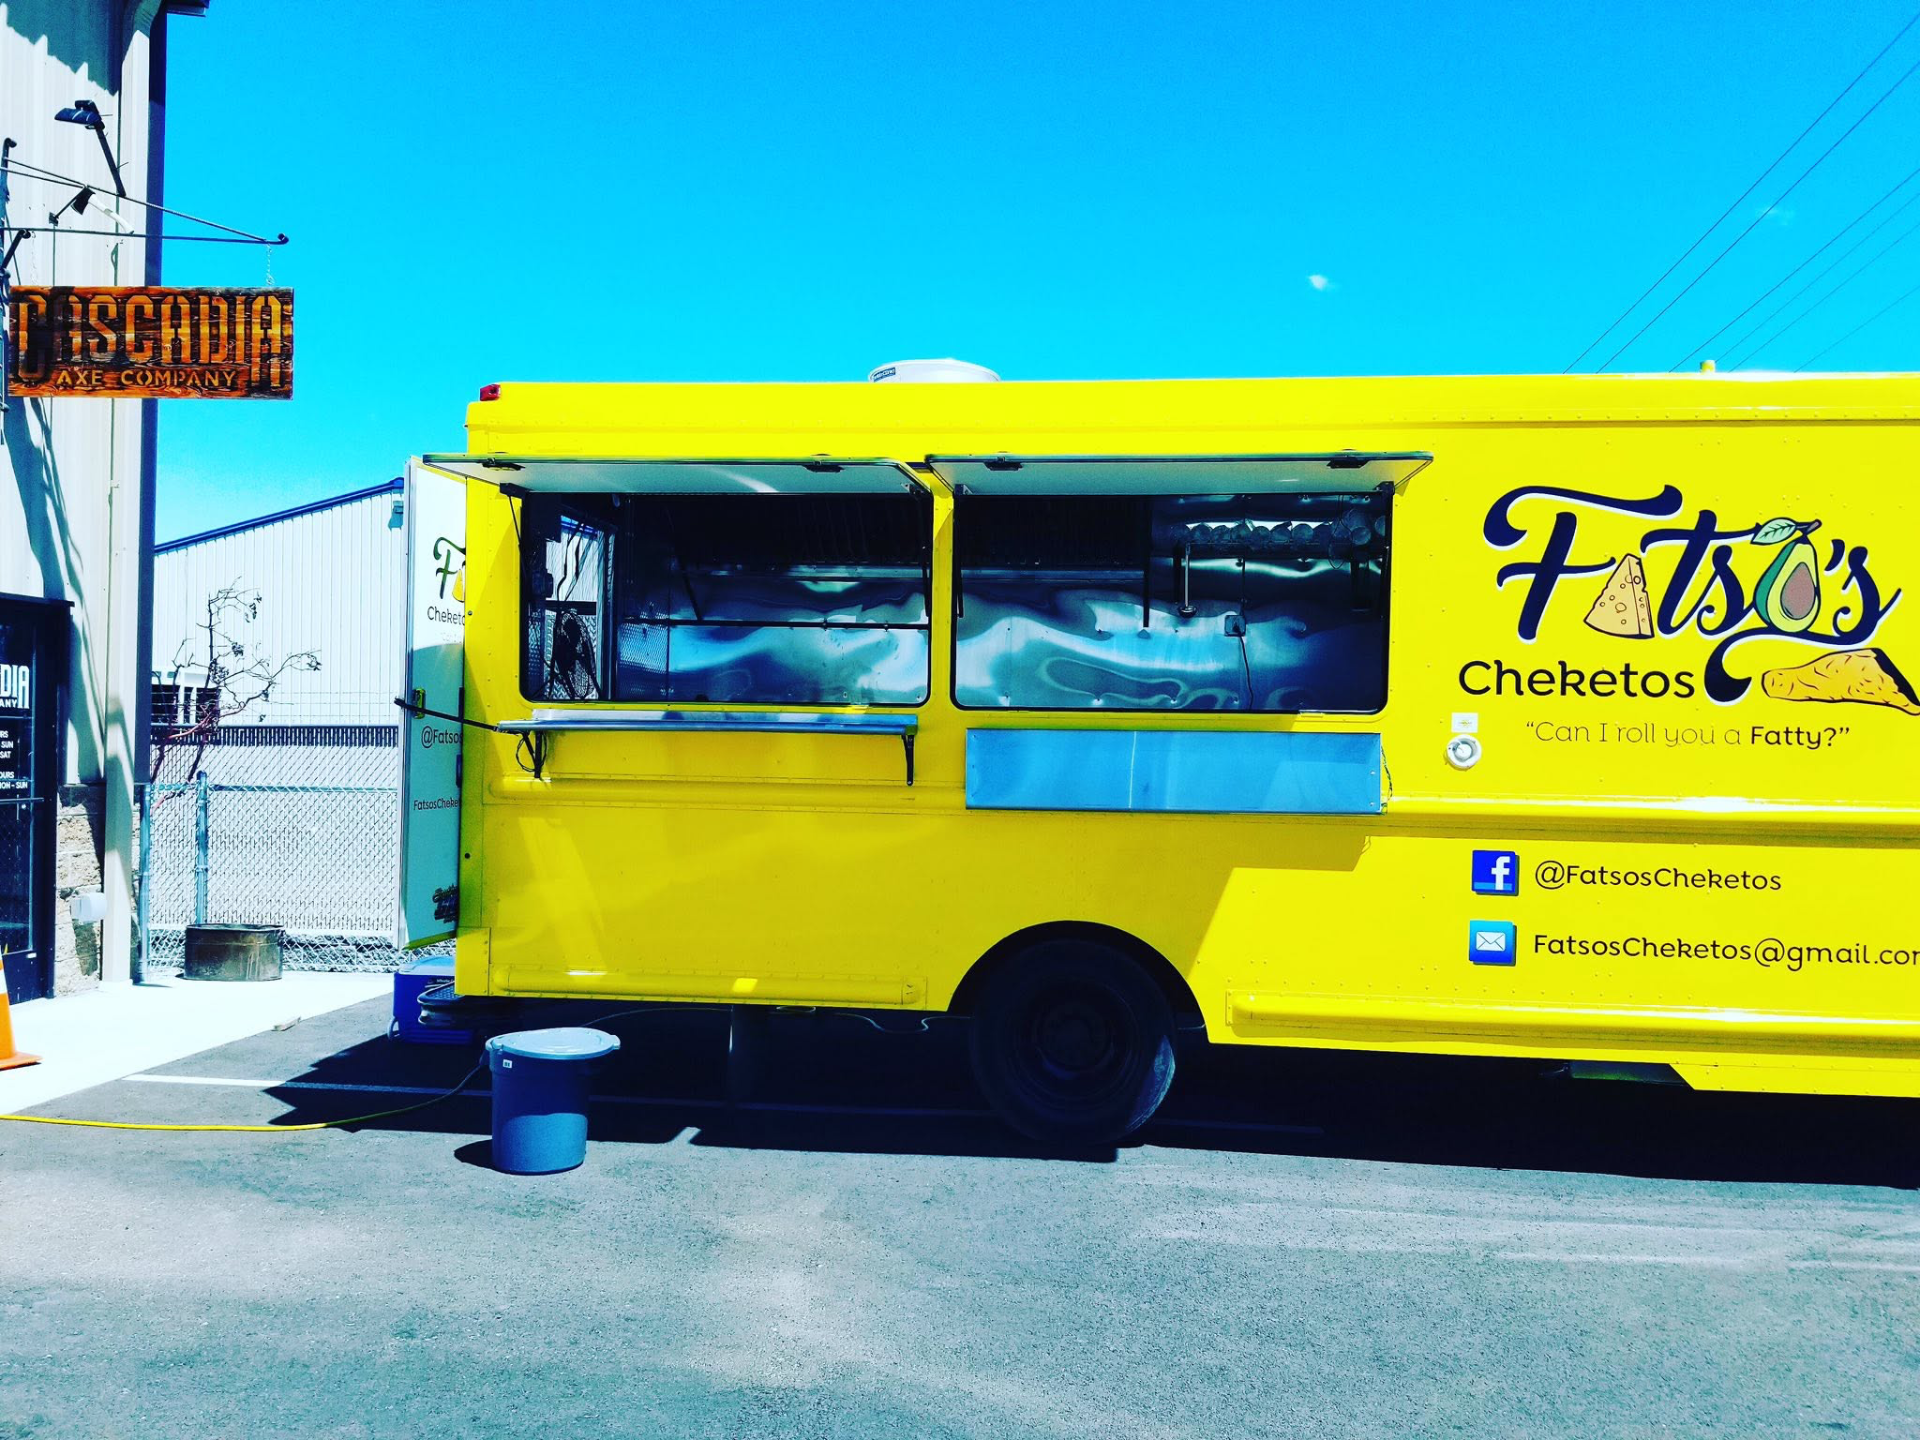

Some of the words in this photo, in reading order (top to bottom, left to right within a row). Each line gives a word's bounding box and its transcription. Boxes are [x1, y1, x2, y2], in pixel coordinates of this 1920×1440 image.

[17, 293, 283, 388] CASCADIA
[57, 370, 104, 386] AXE
[120, 369, 237, 387] COMPANY
[0, 663, 30, 710] DIA
[1458, 659, 1696, 699] Cheketos
[1599, 722, 1608, 743] I
[1616, 722, 1655, 745] roll
[1664, 727, 1715, 748] you
[1724, 728, 1741, 745] a
[15, 781, 28, 789] SUN
[1534, 860, 1782, 891] @FatsosCheketos
